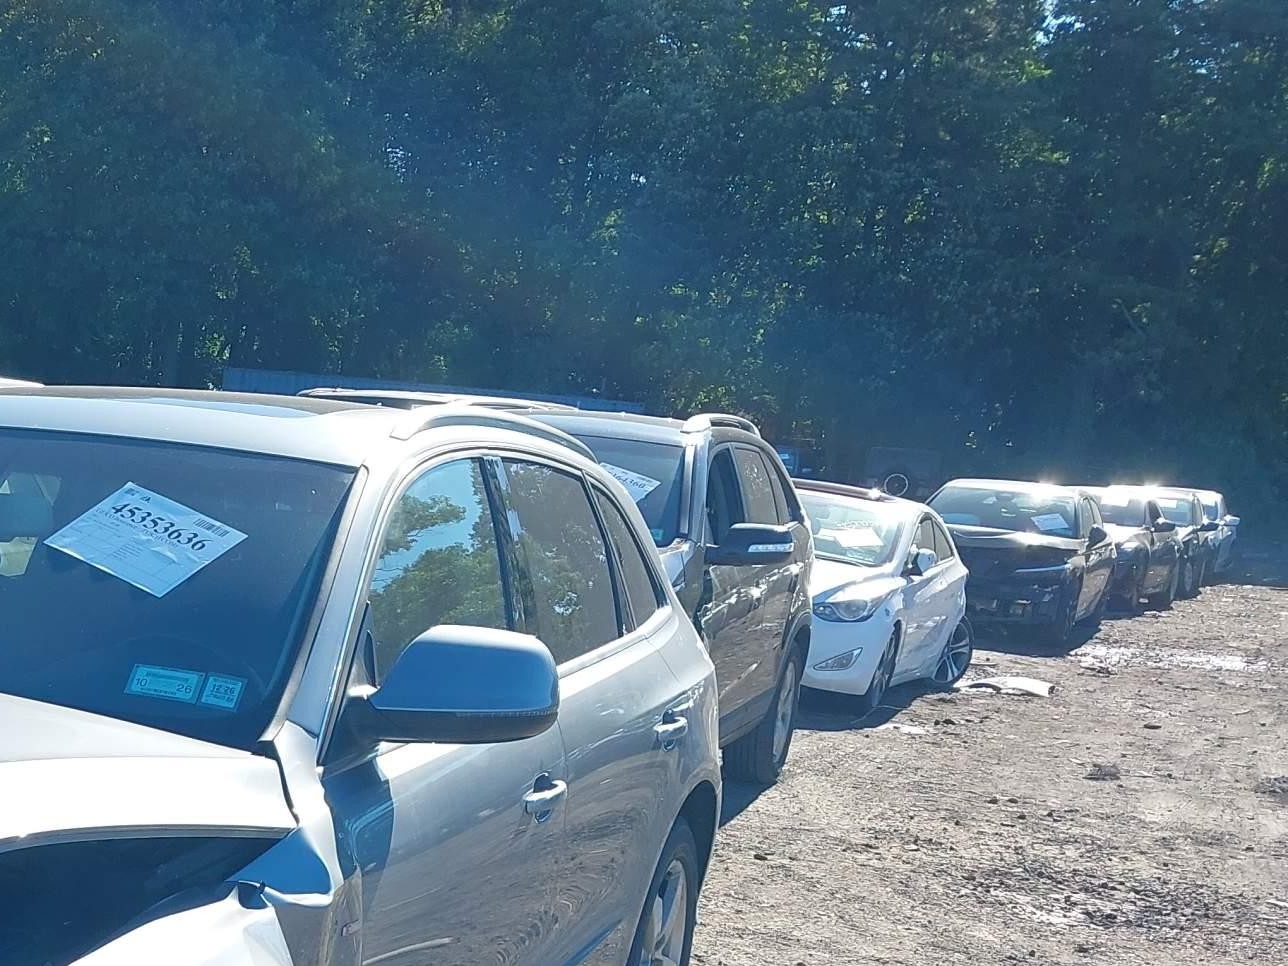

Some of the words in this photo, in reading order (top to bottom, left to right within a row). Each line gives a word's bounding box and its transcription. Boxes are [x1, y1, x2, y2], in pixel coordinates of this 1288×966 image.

[111, 501, 214, 552] 45353636
[135, 678, 148, 687] 10
[176, 683, 193, 694] 26
